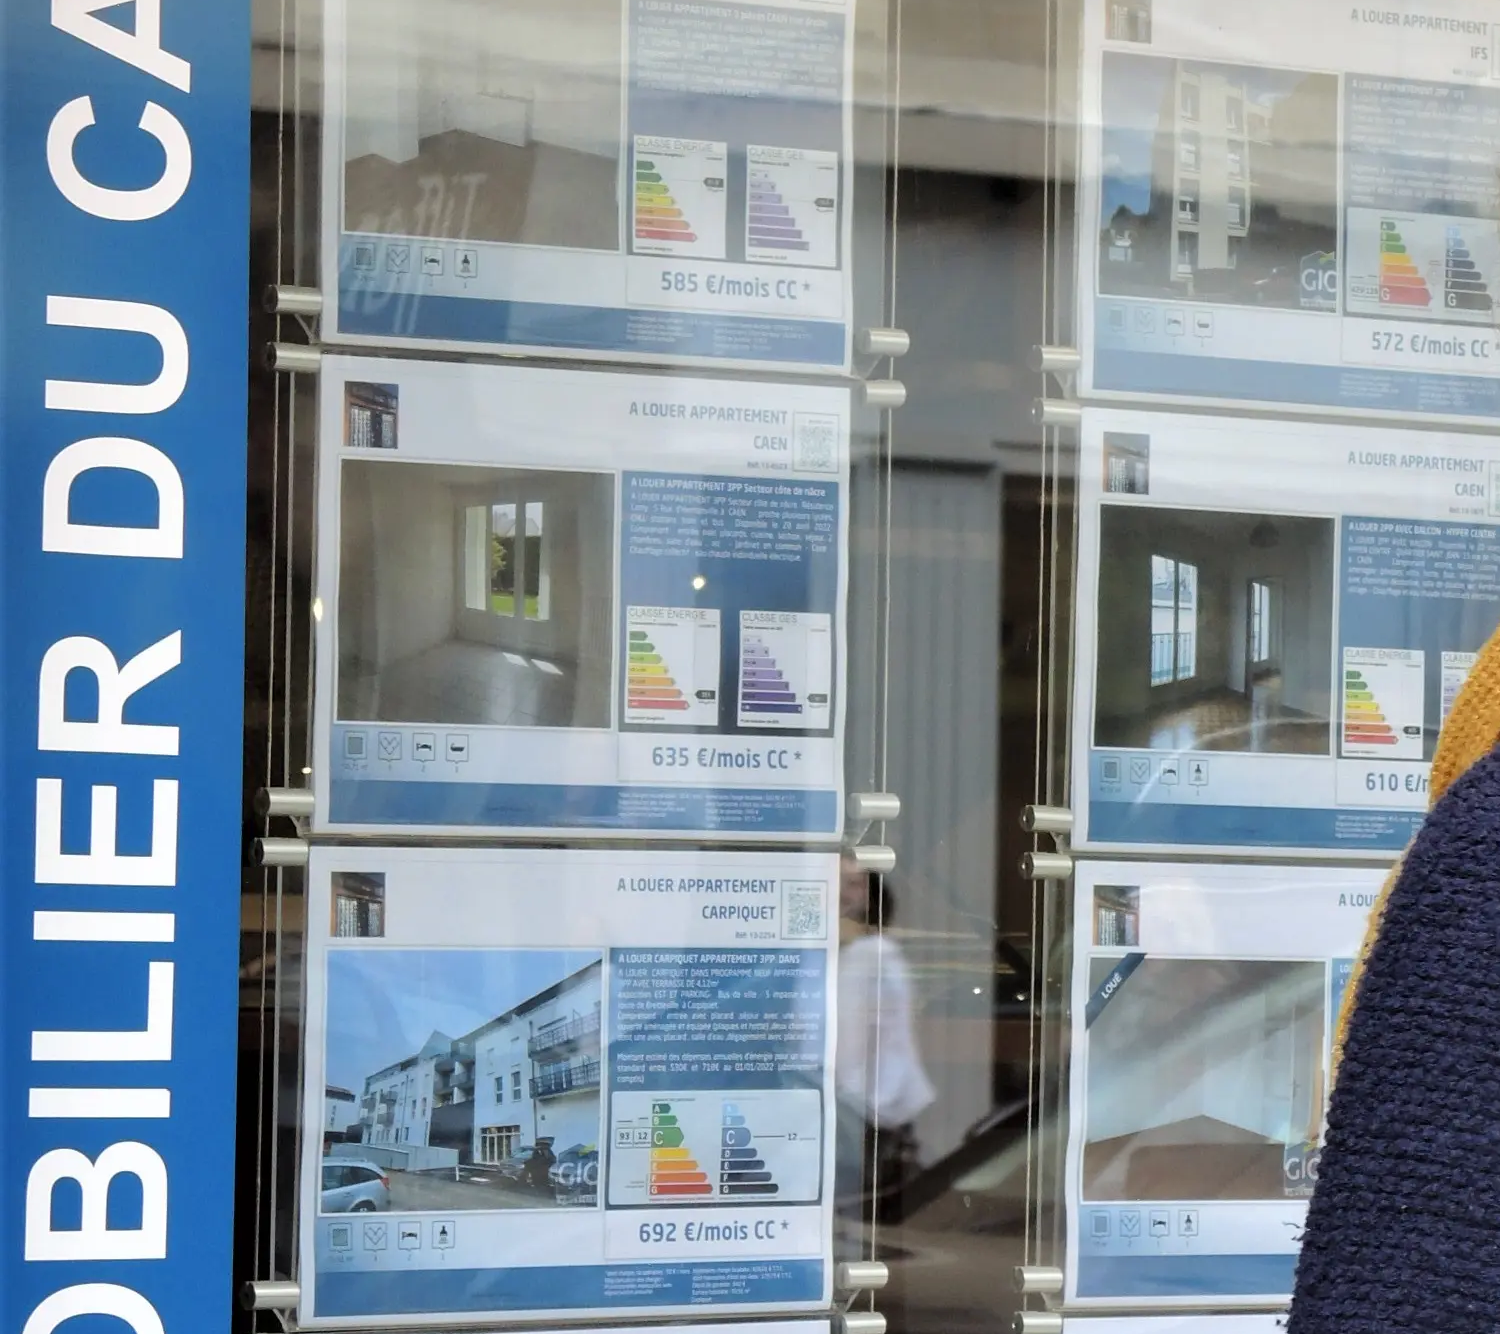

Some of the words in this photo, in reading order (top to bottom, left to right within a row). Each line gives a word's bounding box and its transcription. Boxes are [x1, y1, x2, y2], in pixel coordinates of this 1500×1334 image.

[1350, 8, 1358, 22] A
[1362, 9, 1400, 26] LOUER
[1403, 14, 1488, 36] APPARTEMENT
[1470, 45, 1488, 61] IFS
[660, 270, 699, 294] 585
[706, 274, 770, 299] €/mois
[776, 279, 798, 300] CC
[1372, 331, 1404, 352] 572
[1410, 333, 1466, 357] €/mois
[1470, 339, 1490, 359] CC
[629, 402, 638, 417] A
[642, 403, 686, 419] LOUER
[690, 405, 788, 425] APPARTEMENT
[43, 296, 188, 558] DU
[753, 435, 788, 451] CAEN
[1348, 451, 1356, 464] A
[1359, 452, 1396, 467] LOUER
[1400, 454, 1484, 473] APPARTEMENT
[1454, 483, 1484, 498] CAEN
[652, 746, 690, 767] 635
[697, 747, 761, 770] €/mois
[766, 749, 788, 770] CC
[1365, 773, 1398, 792] 610
[617, 879, 627, 893] A
[630, 879, 674, 893] LOUER
[678, 879, 776, 893] APPARTEMENT
[702, 905, 776, 922] CARPIQUET
[638, 1222, 678, 1244] 692
[684, 1220, 748, 1243] €/mois
[754, 1220, 776, 1240] CC
